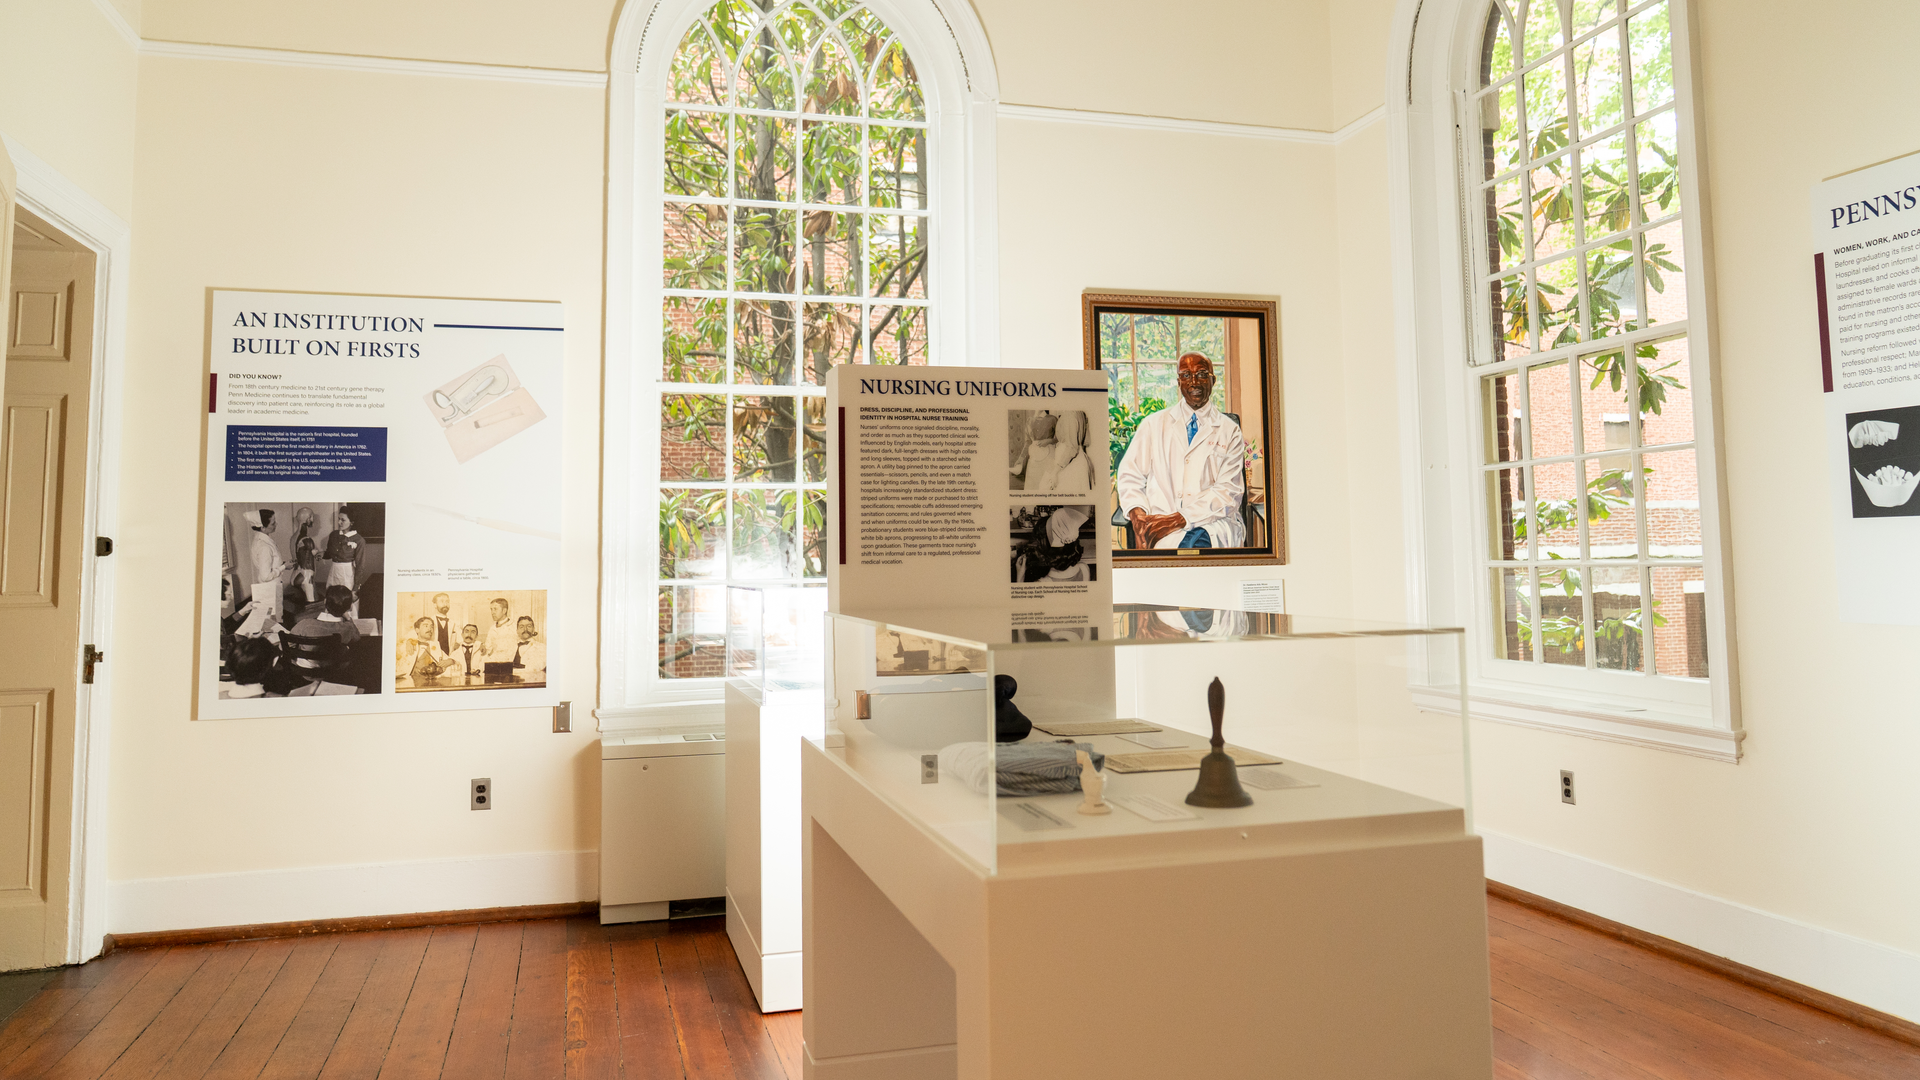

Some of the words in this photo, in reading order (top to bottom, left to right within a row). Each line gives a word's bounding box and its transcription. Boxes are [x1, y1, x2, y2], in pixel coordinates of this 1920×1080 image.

[1833, 243, 1864, 255] WOMEN,
[1865, 236, 1891, 248] WORK,
[1892, 231, 1909, 241] AND
[1834, 259, 1855, 269] Before
[1856, 251, 1890, 265] graduating
[1900, 244, 1914, 253] first
[1835, 267, 1861, 279] Hospital
[1862, 263, 1880, 273] relied
[1891, 255, 1918, 266] informal
[1876, 273, 1889, 282] and
[1889, 269, 1910, 279] cooks
[1836, 289, 1865, 301] assigned
[1873, 283, 1896, 293] female
[1896, 279, 1917, 288] wards
[1837, 298, 1881, 312] administrative
[1882, 292, 1907, 302] records
[233, 312, 267, 328] AN
[274, 313, 423, 333] INSTITUTION
[1838, 312, 1857, 322] found
[1839, 324, 1853, 334] paid
[1864, 319, 1888, 328] nursing
[1889, 315, 1902, 324] and
[1839, 335, 1864, 344] training
[1864, 329, 1896, 341] programs
[232, 338, 300, 355] BUILT
[306, 340, 340, 356] ON
[347, 342, 420, 358] FIRSTS
[1840, 348, 1866, 357] Nursing
[1866, 344, 1888, 353] reform
[1889, 338, 1917, 349] followed
[1841, 356, 1880, 369] professional
[1894, 363, 1907, 371] and
[860, 379, 950, 396] NURSING
[955, 381, 1057, 397] UNIFORMS
